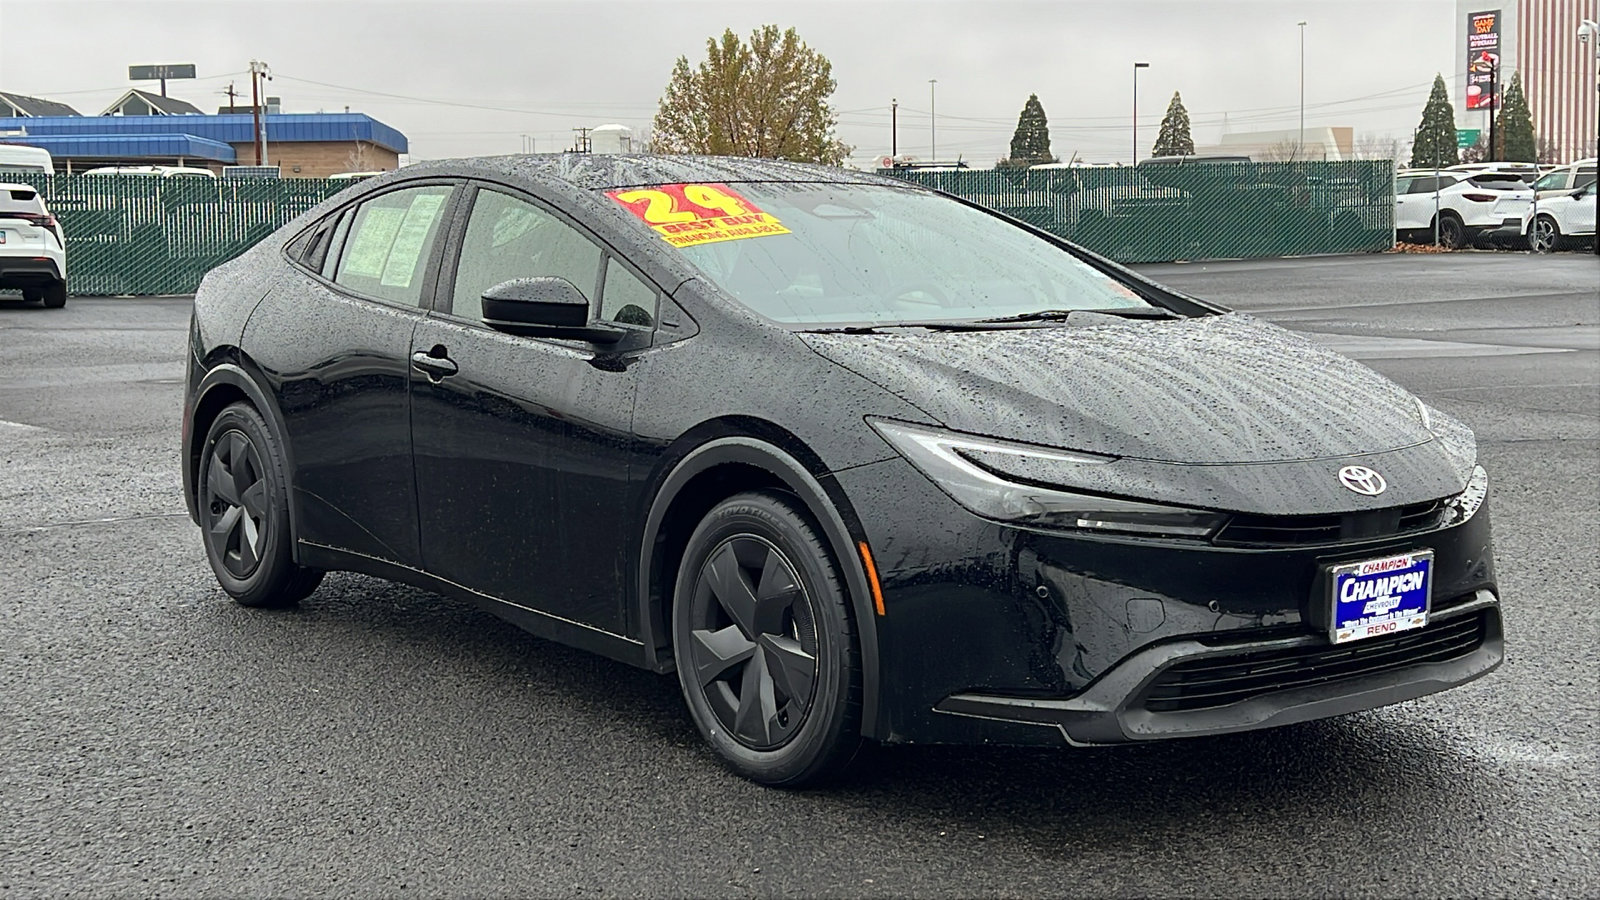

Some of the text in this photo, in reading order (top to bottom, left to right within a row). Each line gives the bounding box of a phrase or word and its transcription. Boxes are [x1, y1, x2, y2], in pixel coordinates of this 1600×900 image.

[1476, 26, 1492, 34] DAY
[616, 185, 747, 224] 24
[662, 214, 766, 234] BEST BUY
[667, 224, 785, 245] FINANCING AVAILABLE
[1362, 558, 1409, 575] CHAMPION
[1340, 571, 1425, 603] CHAMPION
[1366, 599, 1398, 611] CHEVROLET
[1367, 622, 1397, 635] RENO
